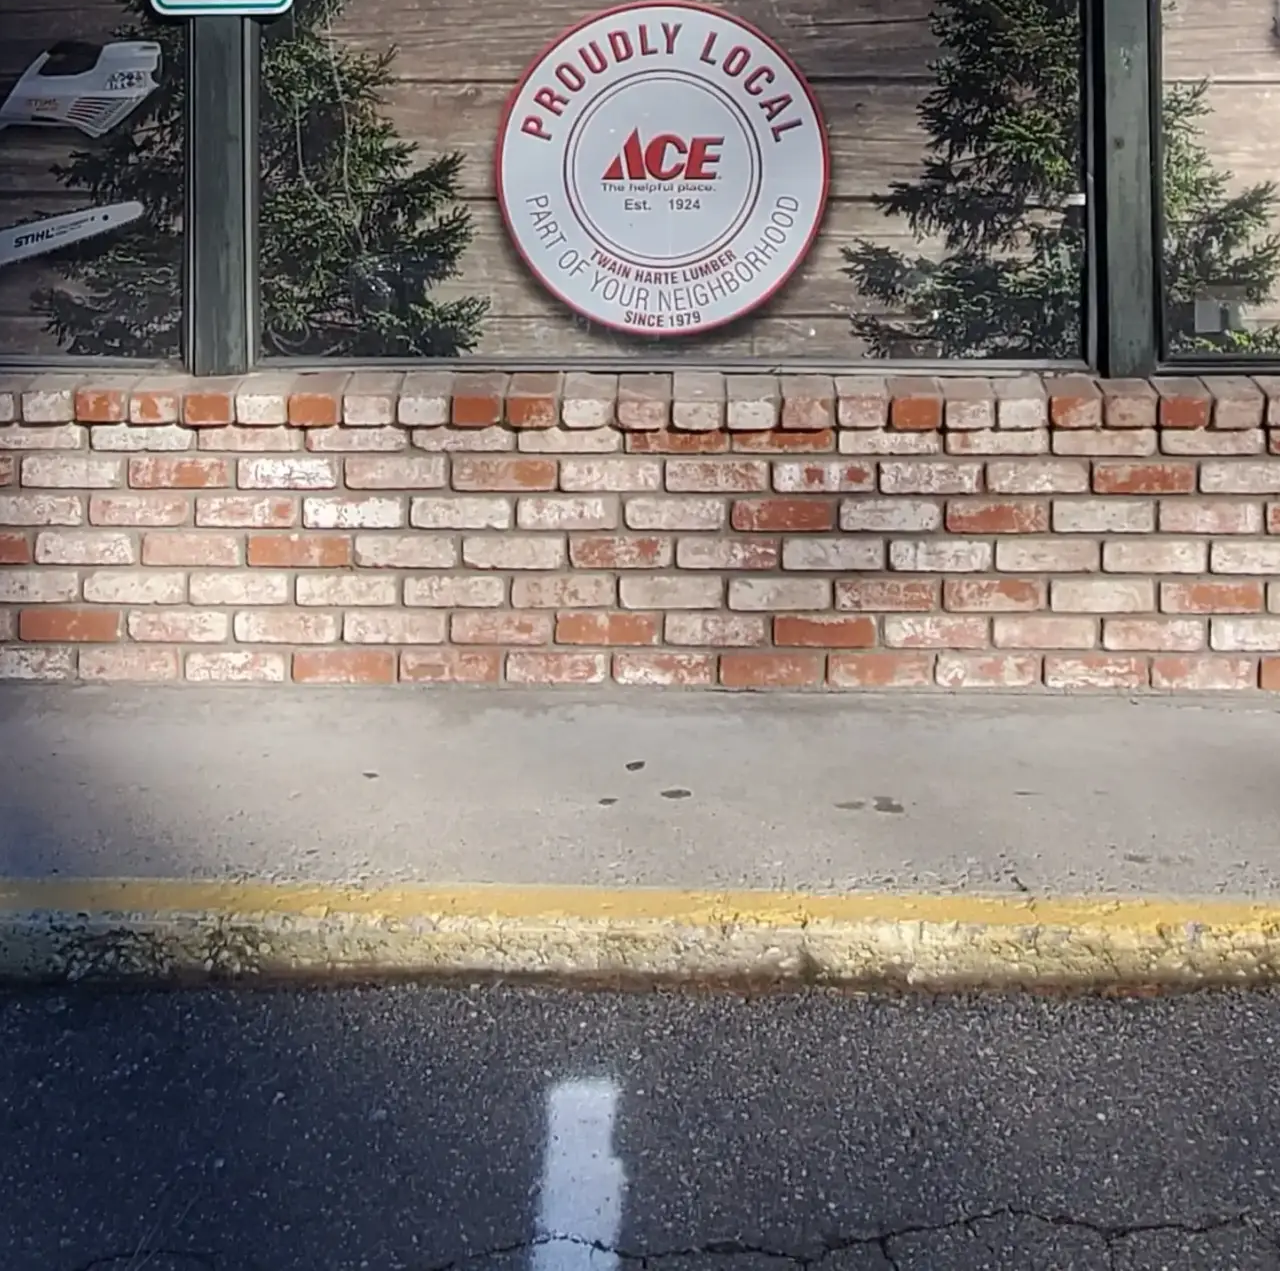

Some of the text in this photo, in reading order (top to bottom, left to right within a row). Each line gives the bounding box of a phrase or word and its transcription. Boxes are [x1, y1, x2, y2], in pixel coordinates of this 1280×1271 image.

[521, 22, 803, 143] PROUDLY LOCAL
[601, 126, 725, 181] ACE
[601, 183, 625, 192] The
[624, 198, 701, 210] Est. 1924
[14, 228, 55, 249] STIHL
[525, 195, 799, 311] PART OF YOUR NEIGHBORHOOD
[590, 249, 737, 285] TWAIN HARTE LUMBER
[624, 310, 702, 328] SINCE 1979
